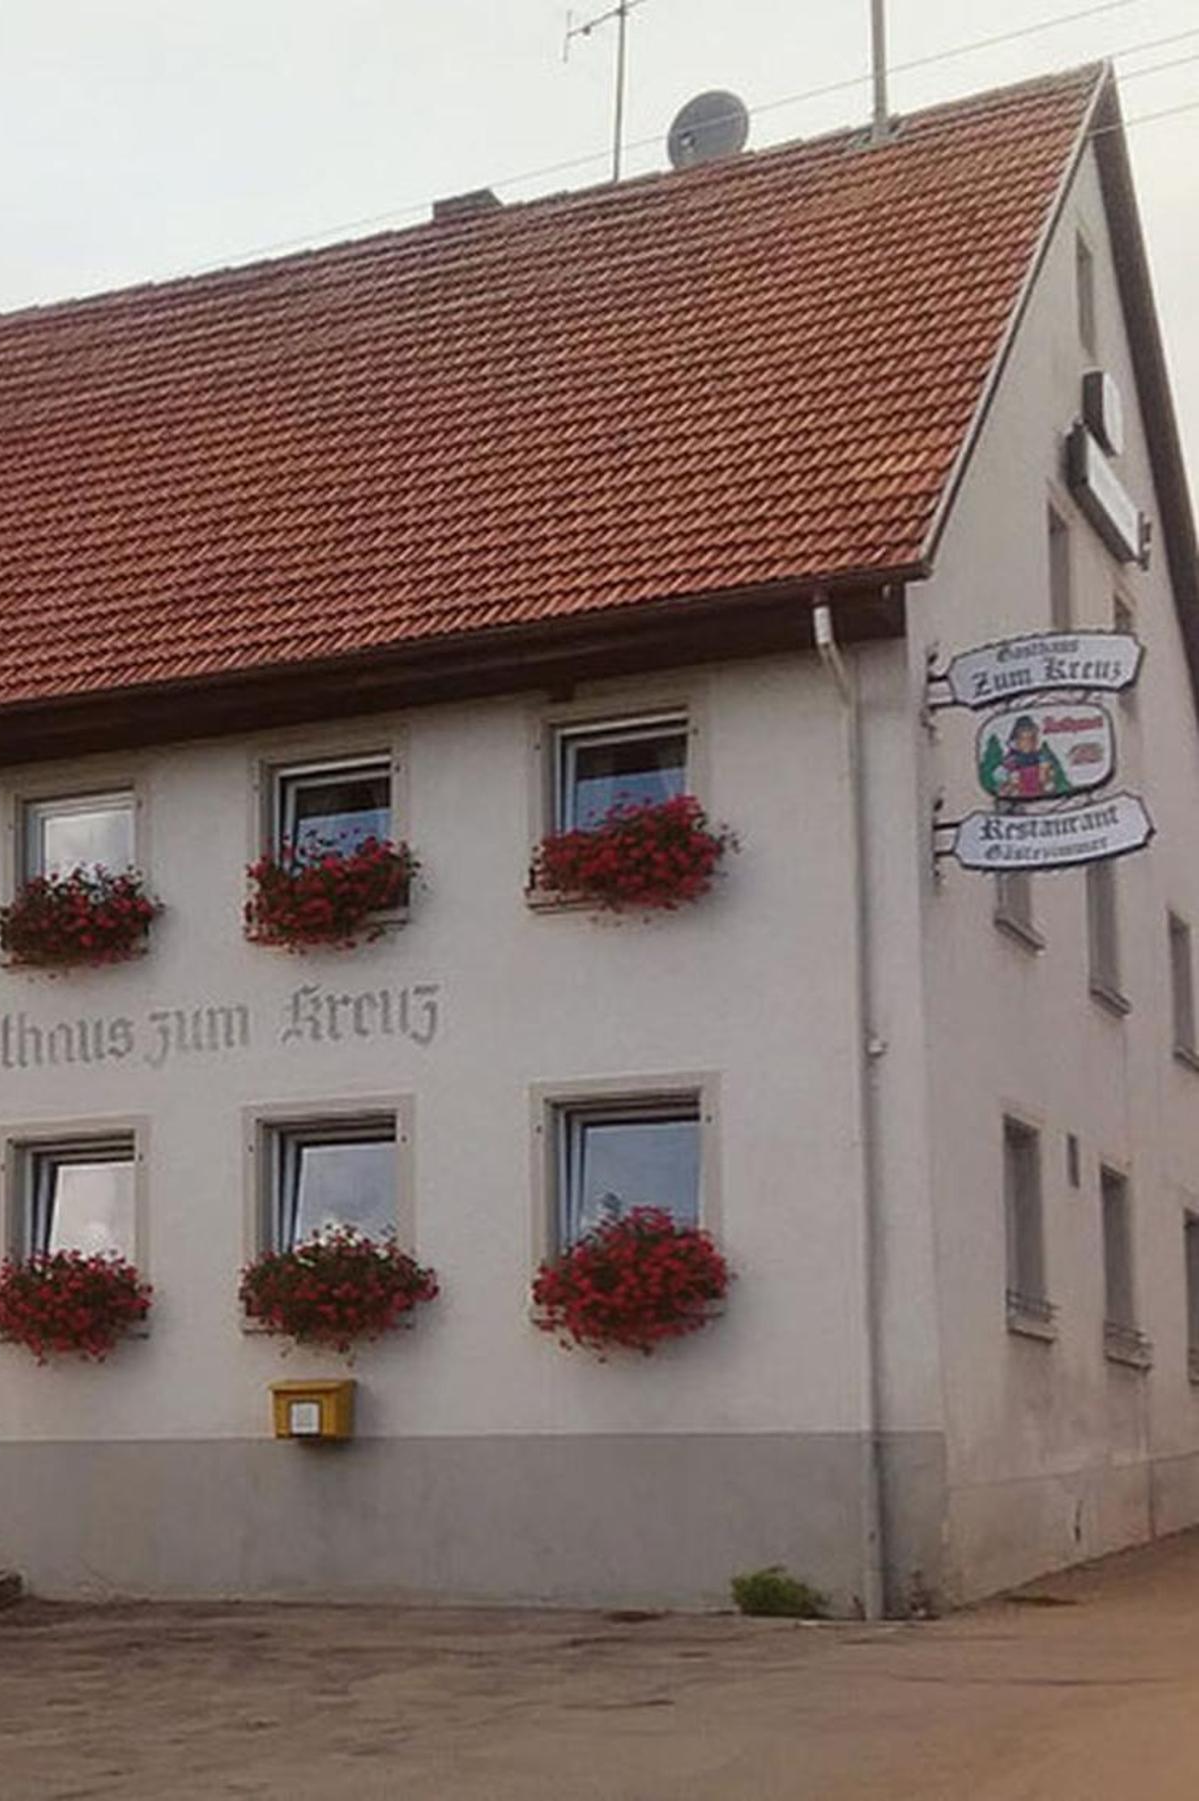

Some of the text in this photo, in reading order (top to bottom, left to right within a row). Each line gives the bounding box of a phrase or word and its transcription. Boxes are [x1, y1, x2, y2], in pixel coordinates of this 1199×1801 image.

[971, 657, 1123, 697] Zum Kreuz
[979, 806, 1120, 841] Restaurant
[143, 1003, 249, 1068] zum
[281, 984, 440, 1046] Kreuz
